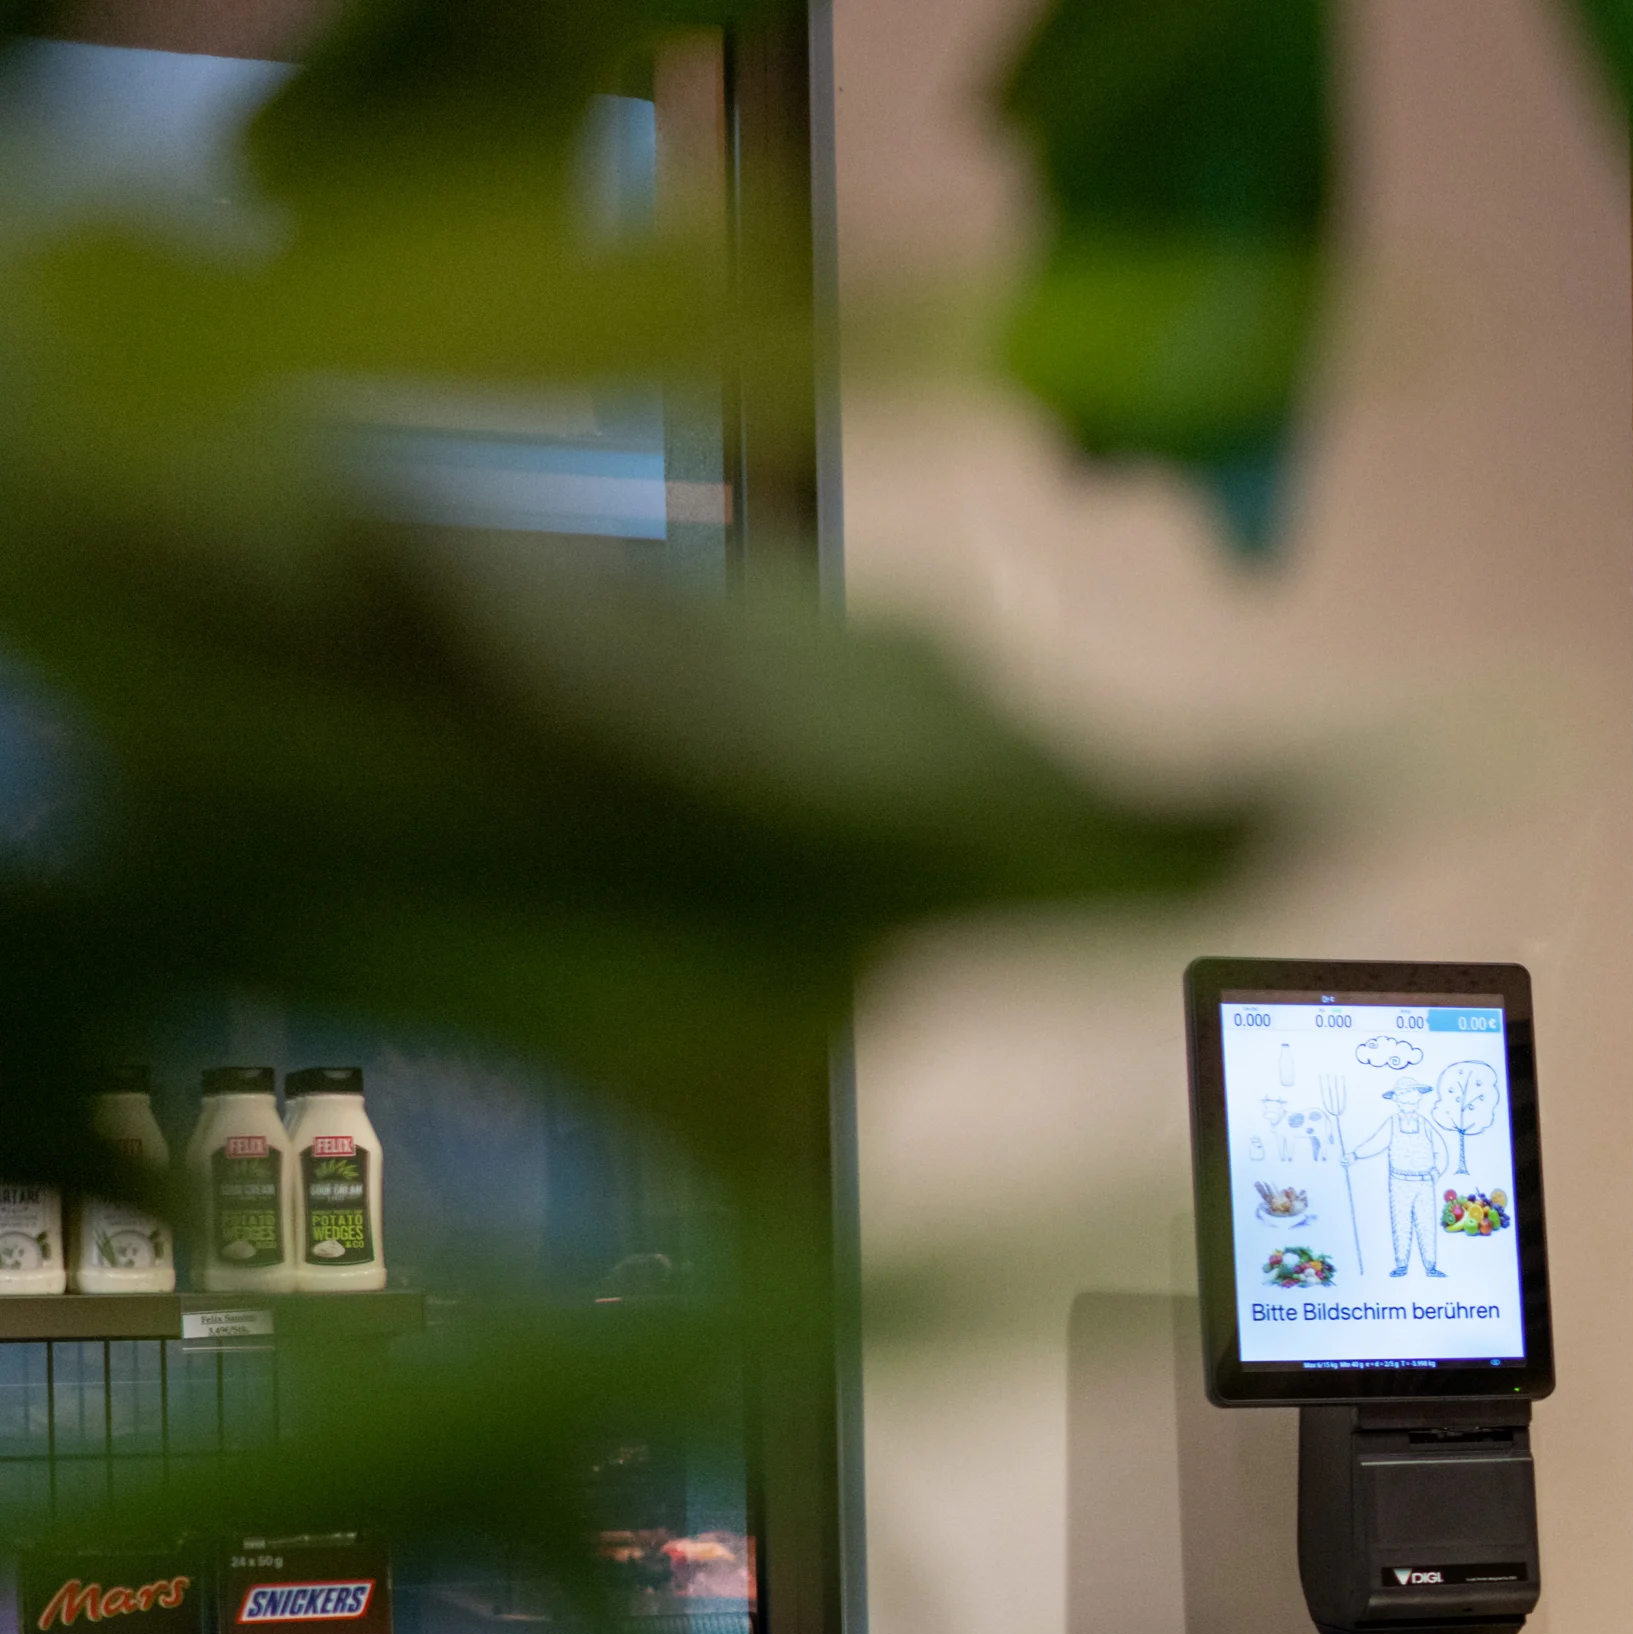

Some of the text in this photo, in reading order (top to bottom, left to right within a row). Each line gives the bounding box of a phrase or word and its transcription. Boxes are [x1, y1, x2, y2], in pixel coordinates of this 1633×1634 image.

[1233, 1013, 1271, 1027] 0.000
[1315, 1014, 1352, 1028] 0.000
[1396, 1015, 1424, 1030] 0.00
[317, 1138, 352, 1154] FELIX
[312, 1214, 364, 1226] POTATO
[313, 1226, 364, 1241] WEDGES
[1252, 1301, 1500, 1322] Bitte Bildschirm berühren
[37, 1576, 190, 1632] Mars
[247, 1585, 371, 1619] SNICKERS
